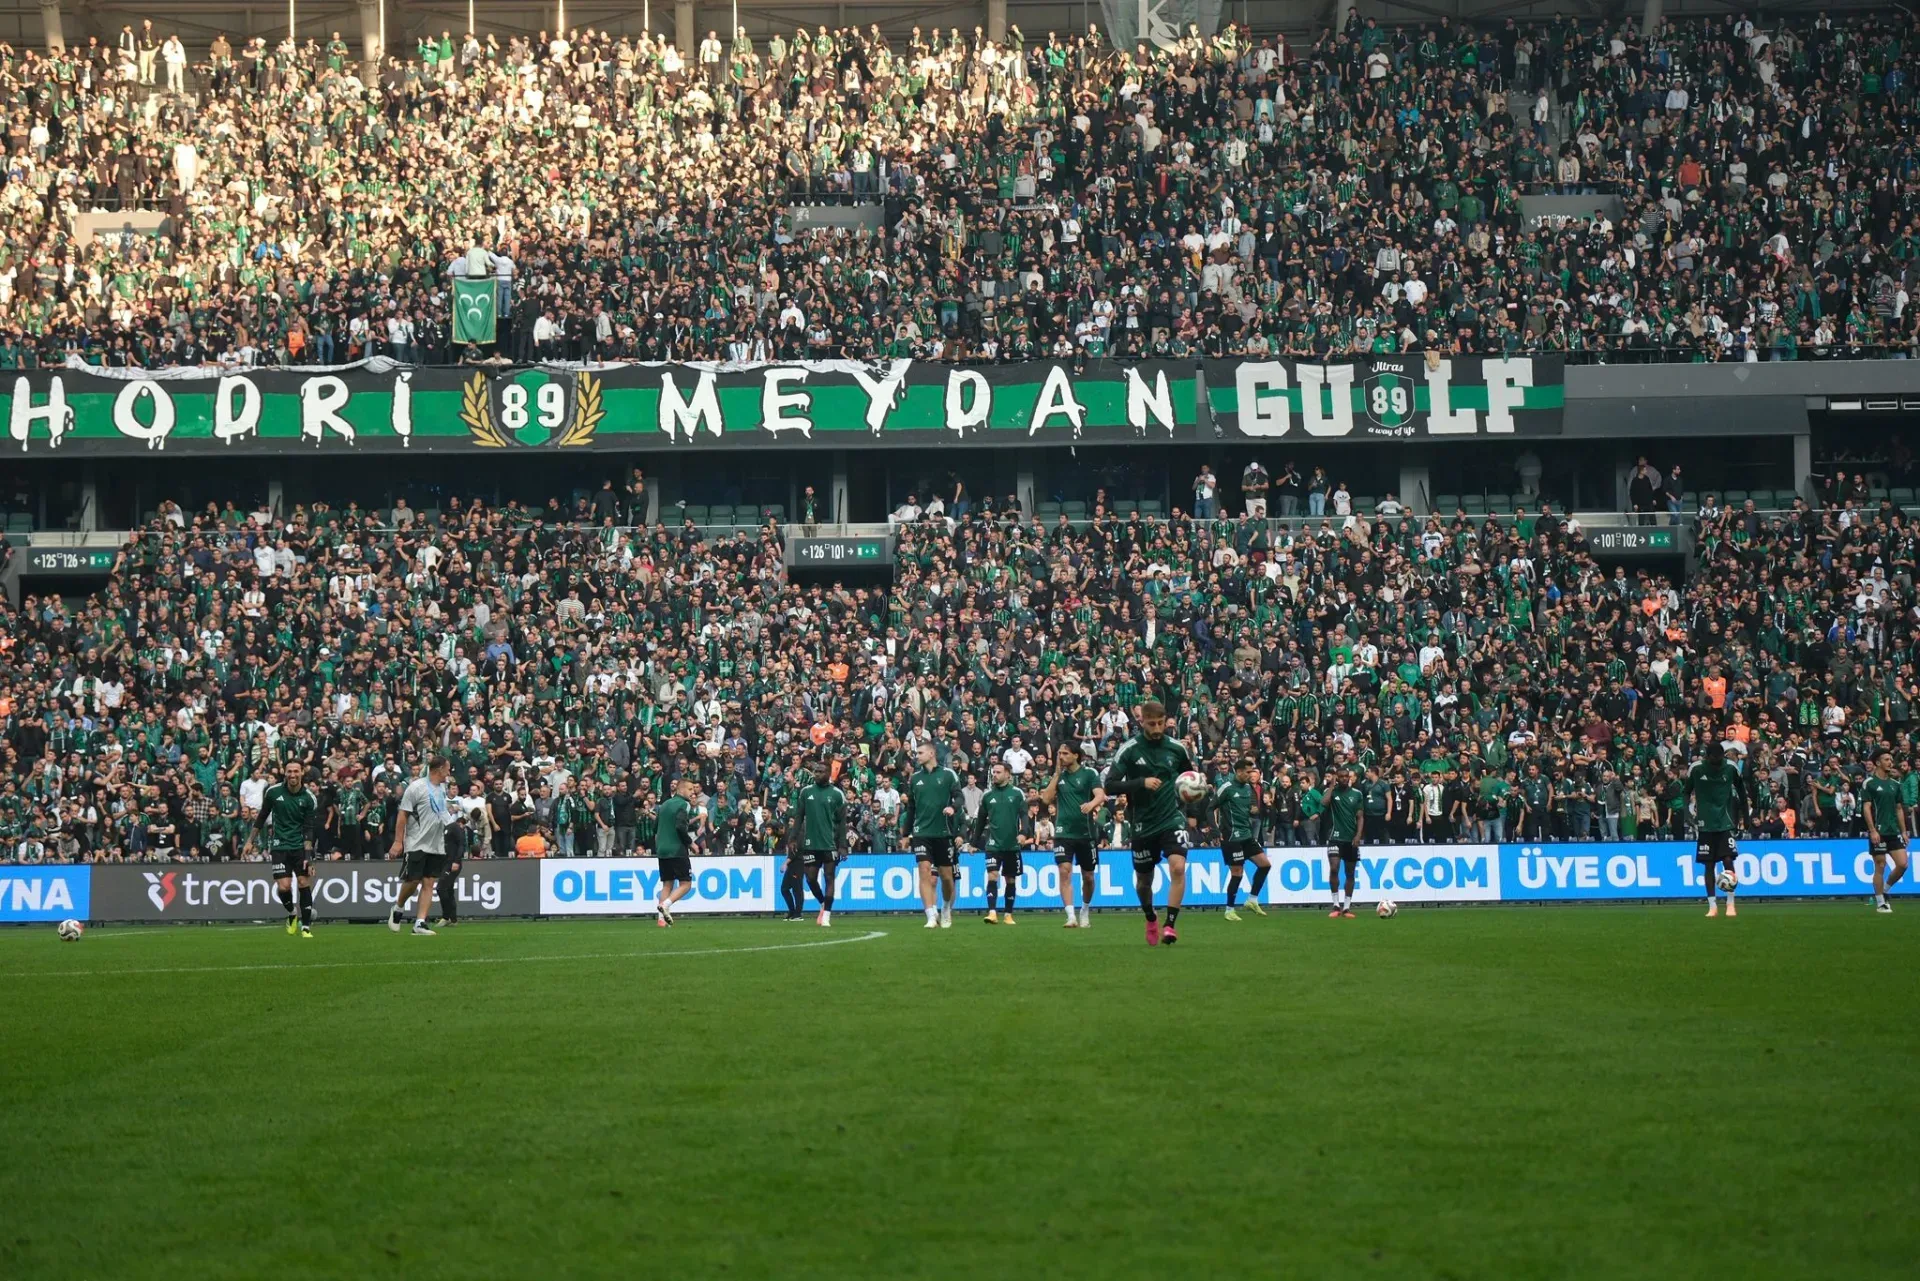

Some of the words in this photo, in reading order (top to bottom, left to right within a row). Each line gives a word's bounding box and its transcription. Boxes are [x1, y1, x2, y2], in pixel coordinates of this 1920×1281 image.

[502, 383, 565, 429] 89
[658, 365, 1175, 443] MEYDAN
[1372, 386, 1407, 414] 89
[1375, 427, 1393, 436] way
[1394, 427, 1403, 436] of
[1601, 533, 1615, 548] 101
[1622, 533, 1637, 548] 102
[41, 554, 57, 568] 125
[63, 554, 78, 568] 126
[809, 544, 825, 559] 126
[831, 544, 844, 559] 101
[1517, 847, 1600, 889] ÜYE
[1606, 854, 1661, 888] OL
[1794, 852, 1846, 885] TL
